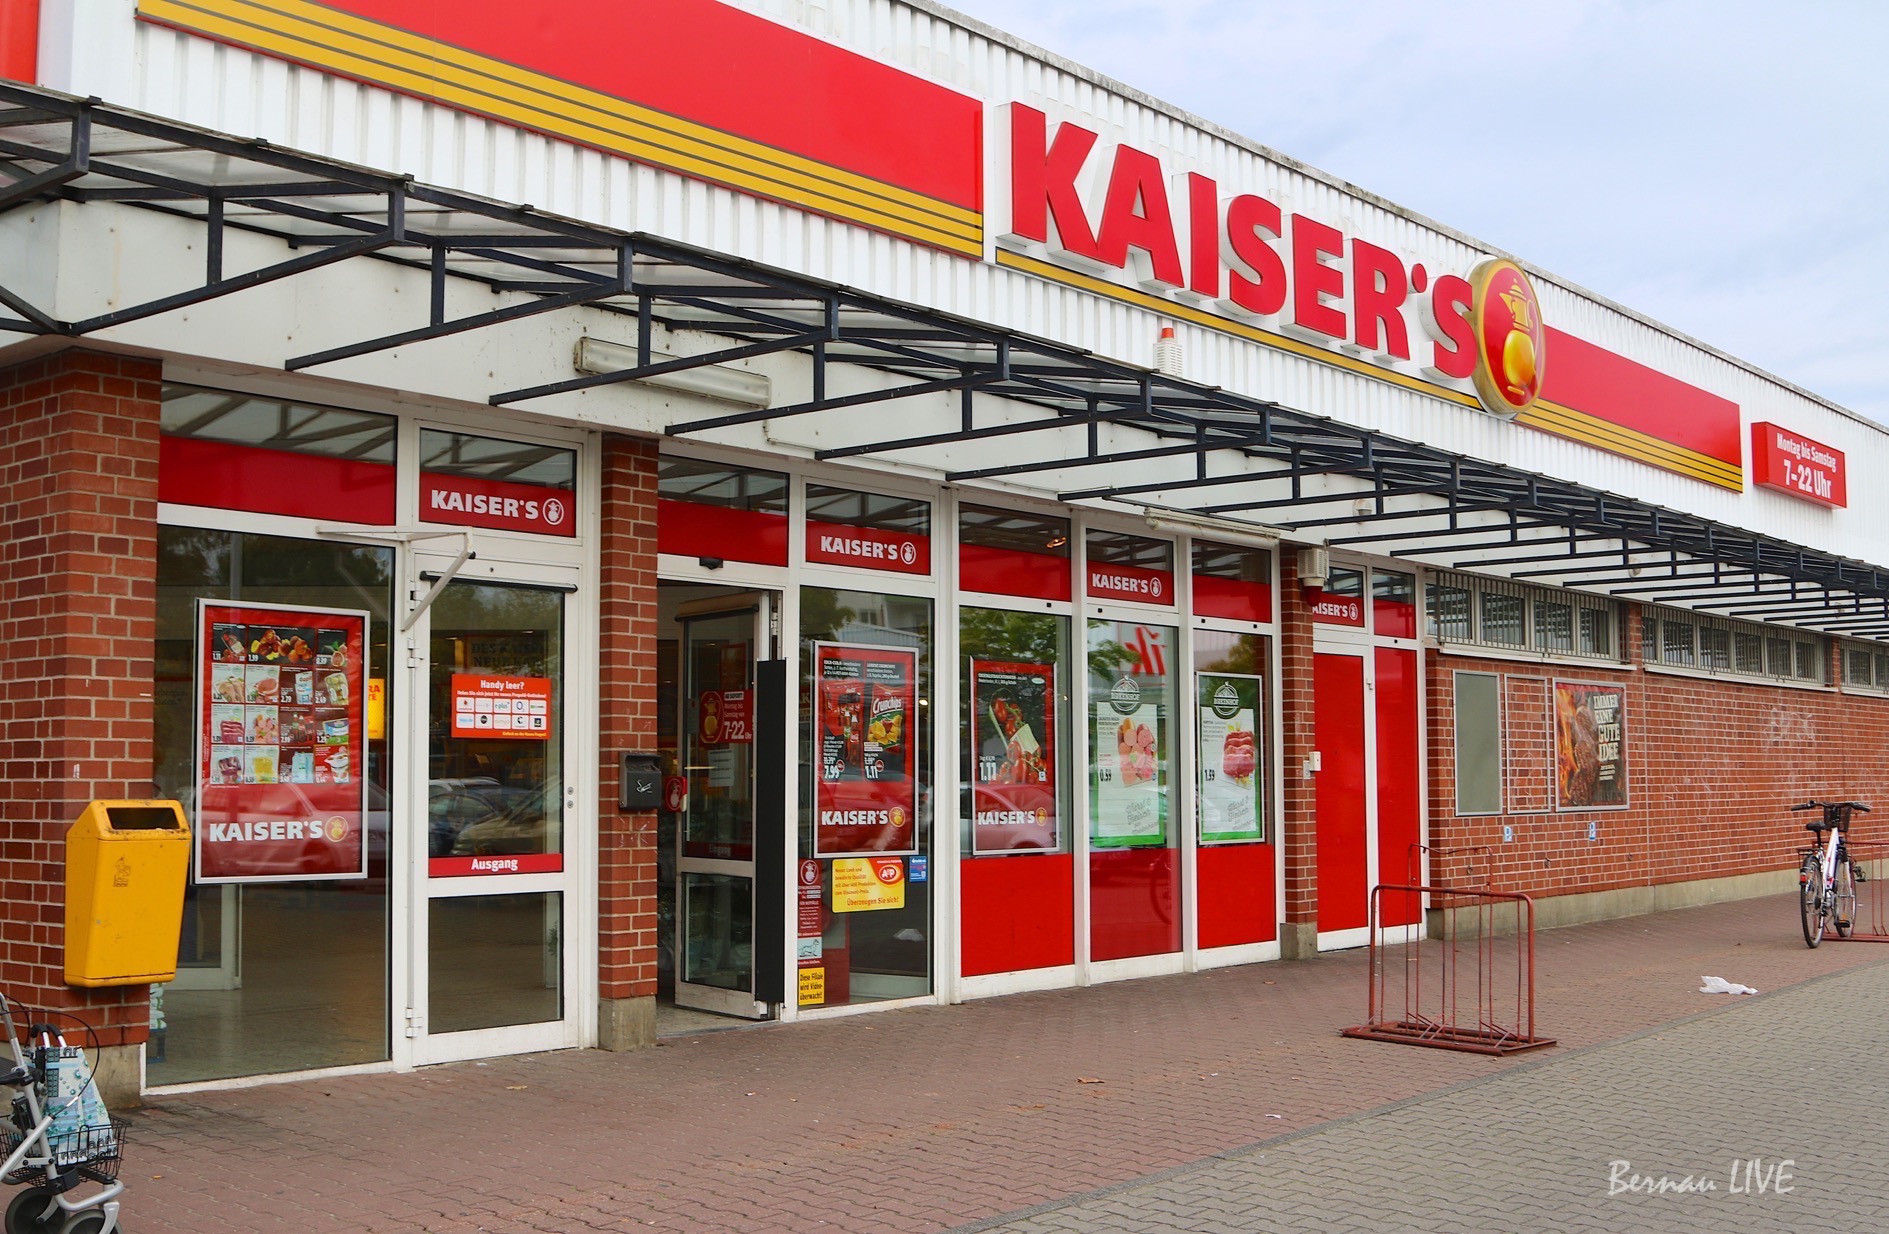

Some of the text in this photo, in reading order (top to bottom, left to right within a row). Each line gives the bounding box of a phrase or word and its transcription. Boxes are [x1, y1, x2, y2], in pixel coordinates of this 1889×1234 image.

[1008, 100, 1476, 379] KAISER'S
[1776, 433, 1837, 473] Montag bis Samstag
[1783, 459, 1832, 499] 7-22 Uhr
[431, 489, 539, 519] KAISER'S
[820, 535, 898, 560] KAISER'S
[1092, 573, 1149, 593] KAISER'S
[248, 654, 258, 662] 1.99
[480, 680, 524, 691] Handy leer?
[873, 696, 902, 714] Crunchips
[1593, 694, 1619, 709] IMMER
[1594, 709, 1614, 723] EINE
[724, 721, 745, 740] 7-22
[1598, 724, 1620, 742] GUTE
[1598, 742, 1619, 761] IDEE
[824, 765, 840, 779] 7.99
[865, 766, 878, 779] 1.11
[980, 762, 996, 780] 1.11
[822, 810, 889, 825] KAISER'S
[978, 810, 1035, 825] KAISER'S
[209, 820, 324, 842] KAISER'S
[471, 858, 518, 872] Ausgang
[847, 897, 877, 906] Überzeugen
[800, 991, 822, 1000] überwacht!
